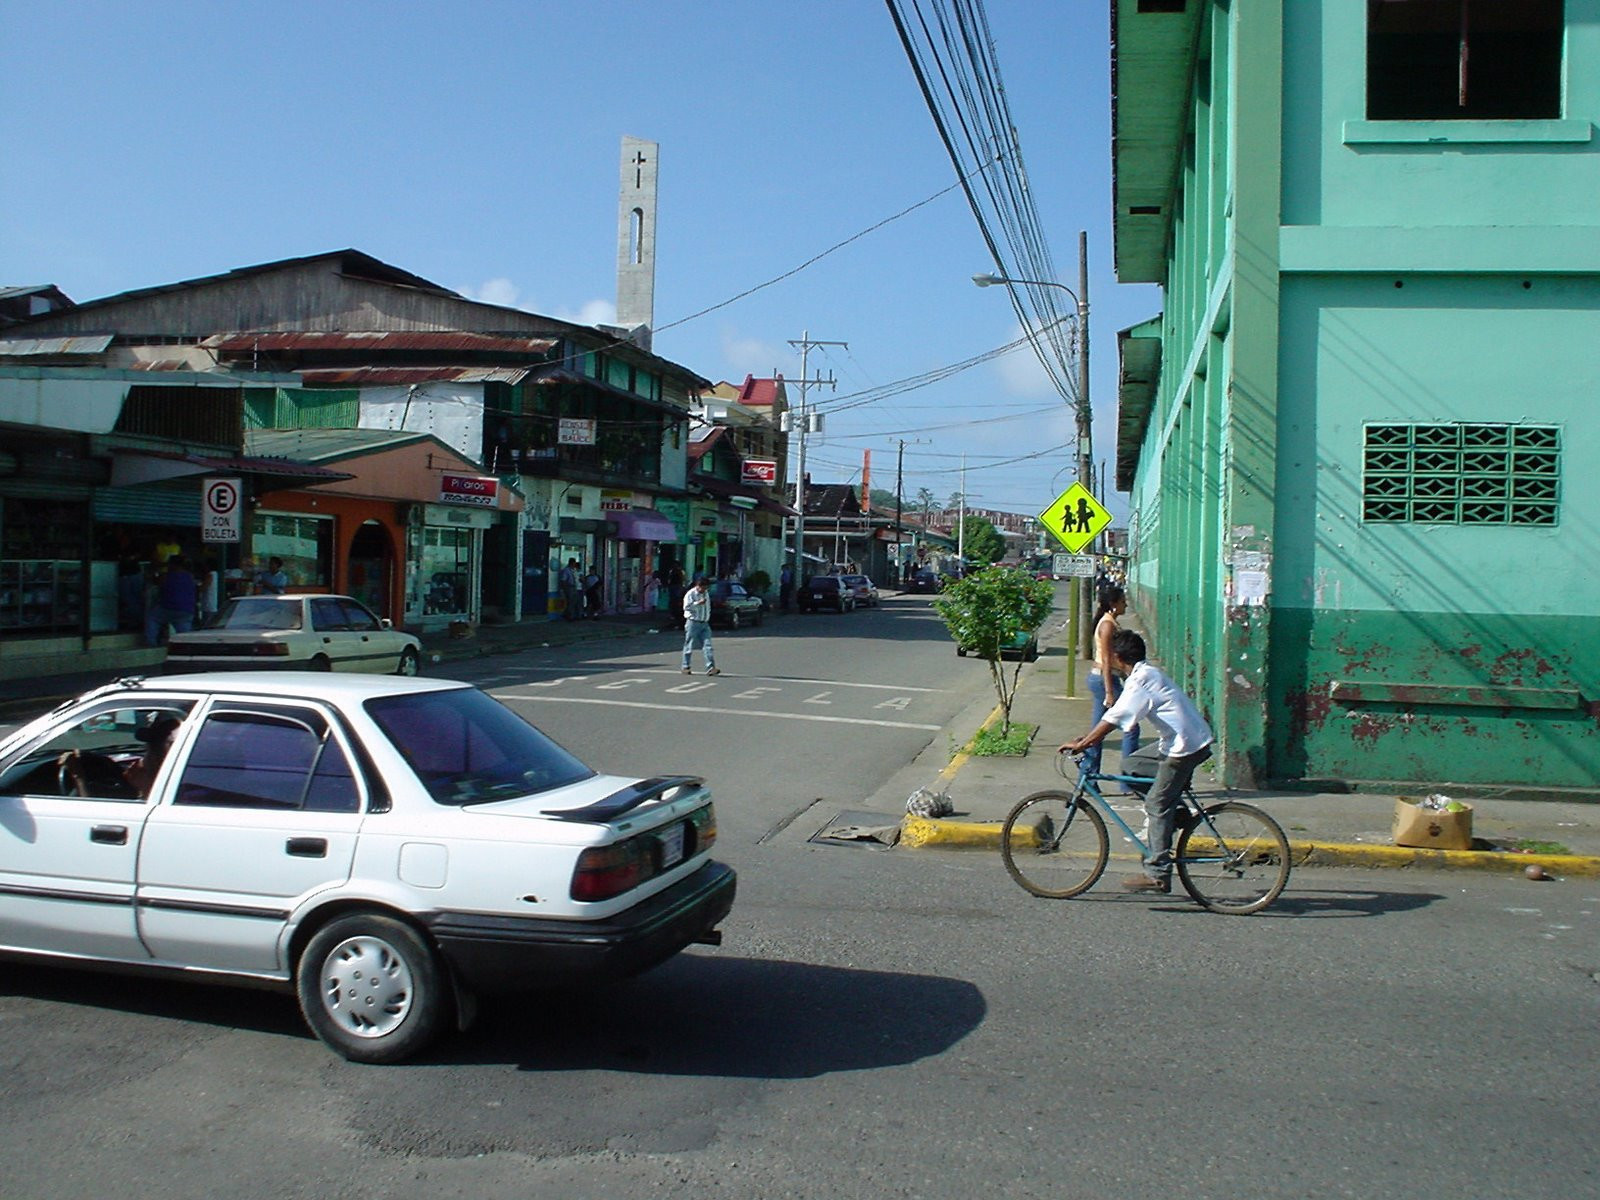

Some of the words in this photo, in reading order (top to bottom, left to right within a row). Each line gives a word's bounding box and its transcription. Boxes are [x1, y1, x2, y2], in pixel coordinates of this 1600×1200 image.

[216, 488, 228, 508] E
[212, 516, 230, 527] CON
[204, 528, 237, 539] BOLETA
